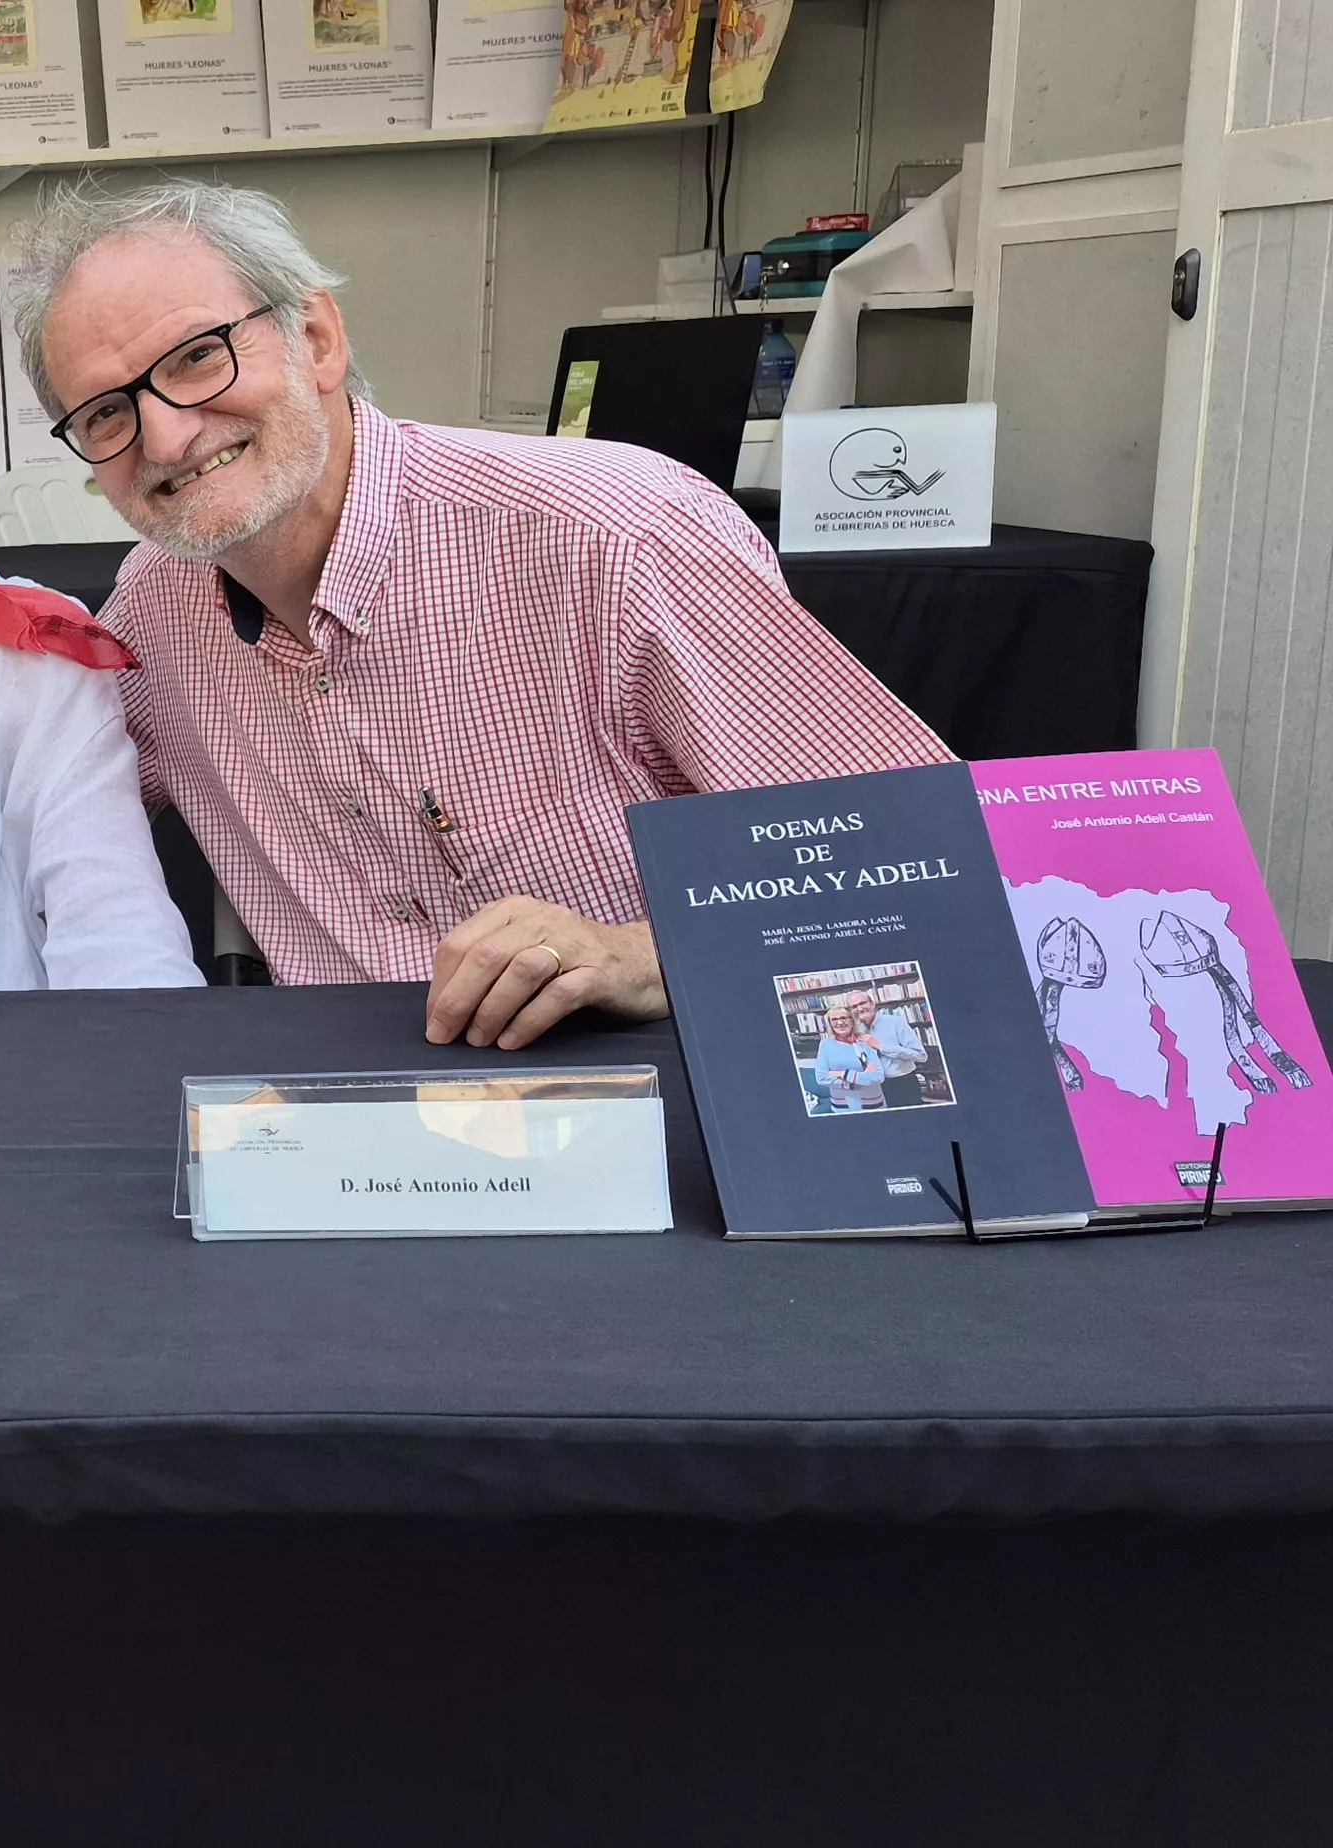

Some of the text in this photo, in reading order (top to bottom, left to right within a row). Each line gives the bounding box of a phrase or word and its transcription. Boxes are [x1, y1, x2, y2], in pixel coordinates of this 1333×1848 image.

[482, 37, 526, 47] MUJERES
[144, 61, 183, 70] MUJERES
[308, 63, 347, 72] MUJERES
[815, 508, 952, 520] ASOCIACIÓN PROVINCIAL
[815, 523, 828, 532] DE
[892, 521, 906, 529] DE
[910, 519, 955, 528] HUESCA
[1022, 781, 1106, 803] ENTRE
[1109, 777, 1203, 798] MITRAS
[749, 812, 865, 843] POEMAS
[1051, 811, 1214, 830] José Antonio Adell Castán
[794, 844, 834, 865] DE
[685, 857, 960, 907] LAMORA Y ADELL
[761, 914, 904, 938] MARÍA JESÚS LAMORA LANAU
[764, 922, 907, 946] JOSÉ ANTONIO ADELL CASTÁN
[1176, 1162, 1212, 1170] EDITORIA
[340, 1176, 532, 1194] D. José Antonio Adell
[887, 1181, 923, 1195] PIRINEO
